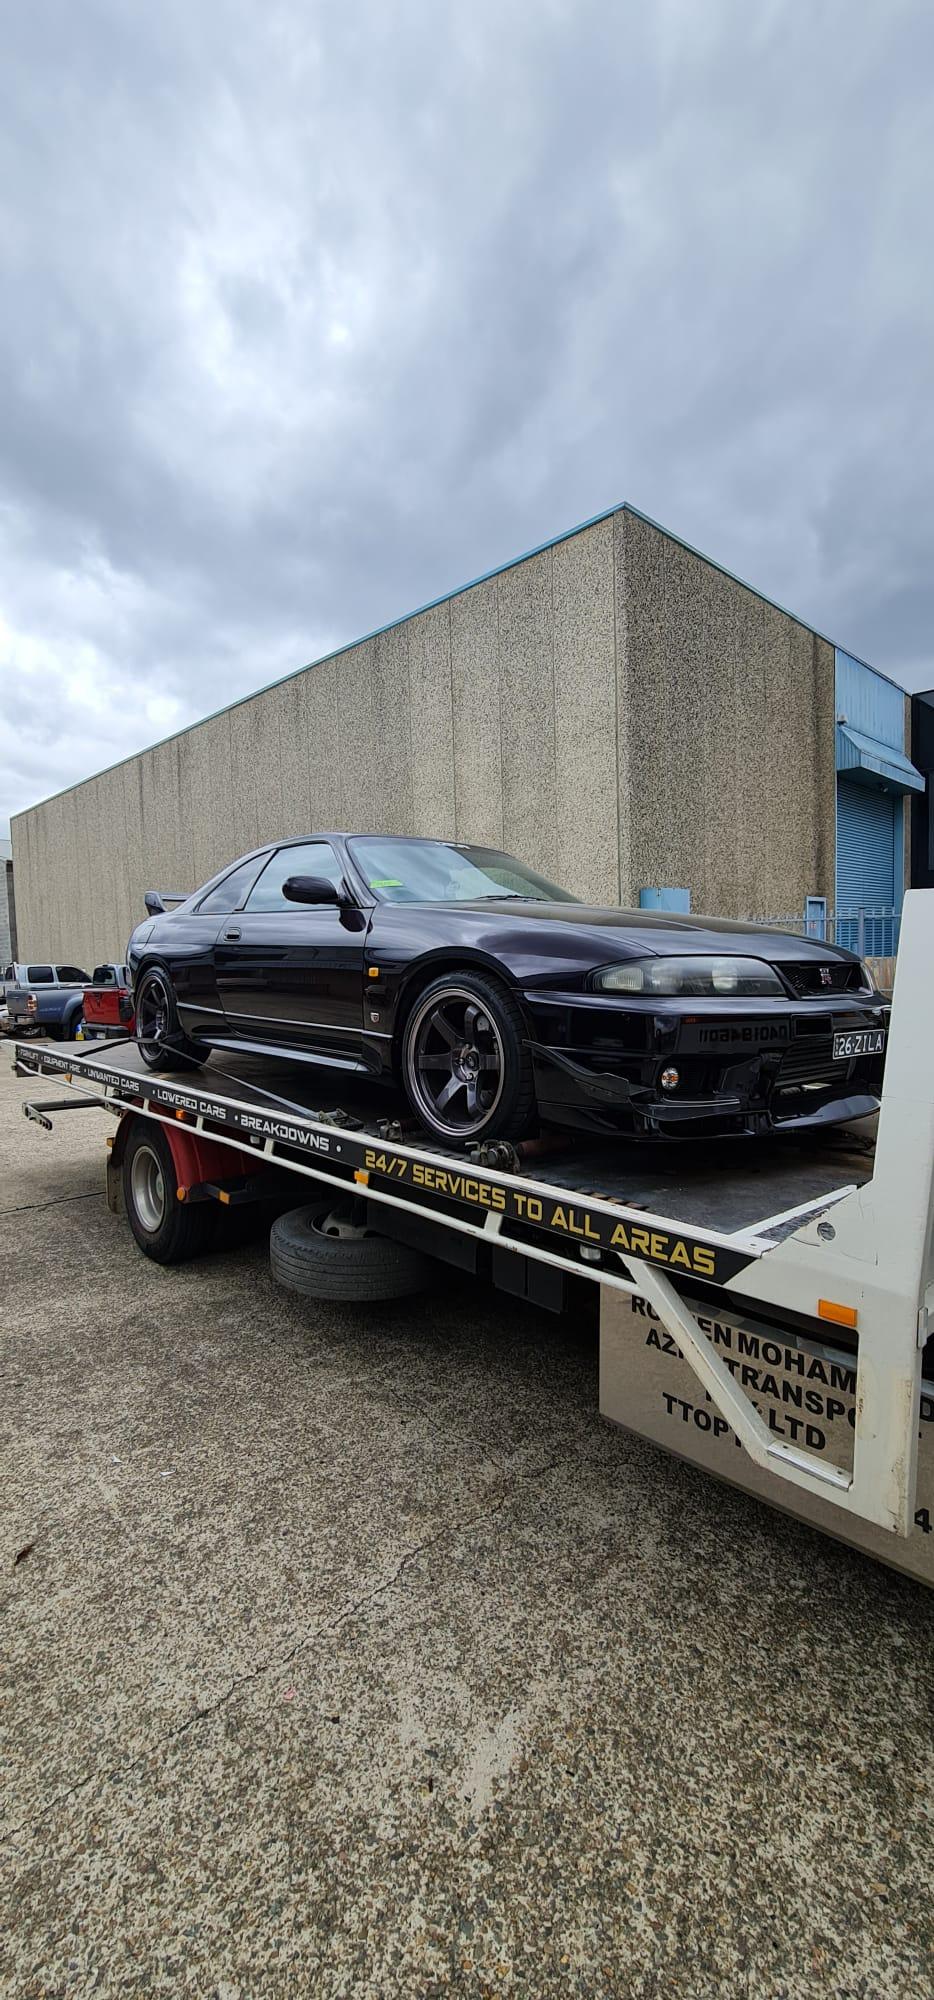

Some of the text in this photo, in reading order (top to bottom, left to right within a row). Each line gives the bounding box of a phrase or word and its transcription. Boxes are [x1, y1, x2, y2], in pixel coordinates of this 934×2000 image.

[87, 1068, 140, 1092] UNWANTED CARS
[157, 1089, 227, 1119] LOWERED CARS
[240, 1114, 330, 1151] BREAKDOWNS
[365, 1150, 716, 1276] 24/7 SERVICES TO ALL AREAS
[768, 1408, 826, 1451] LTD
